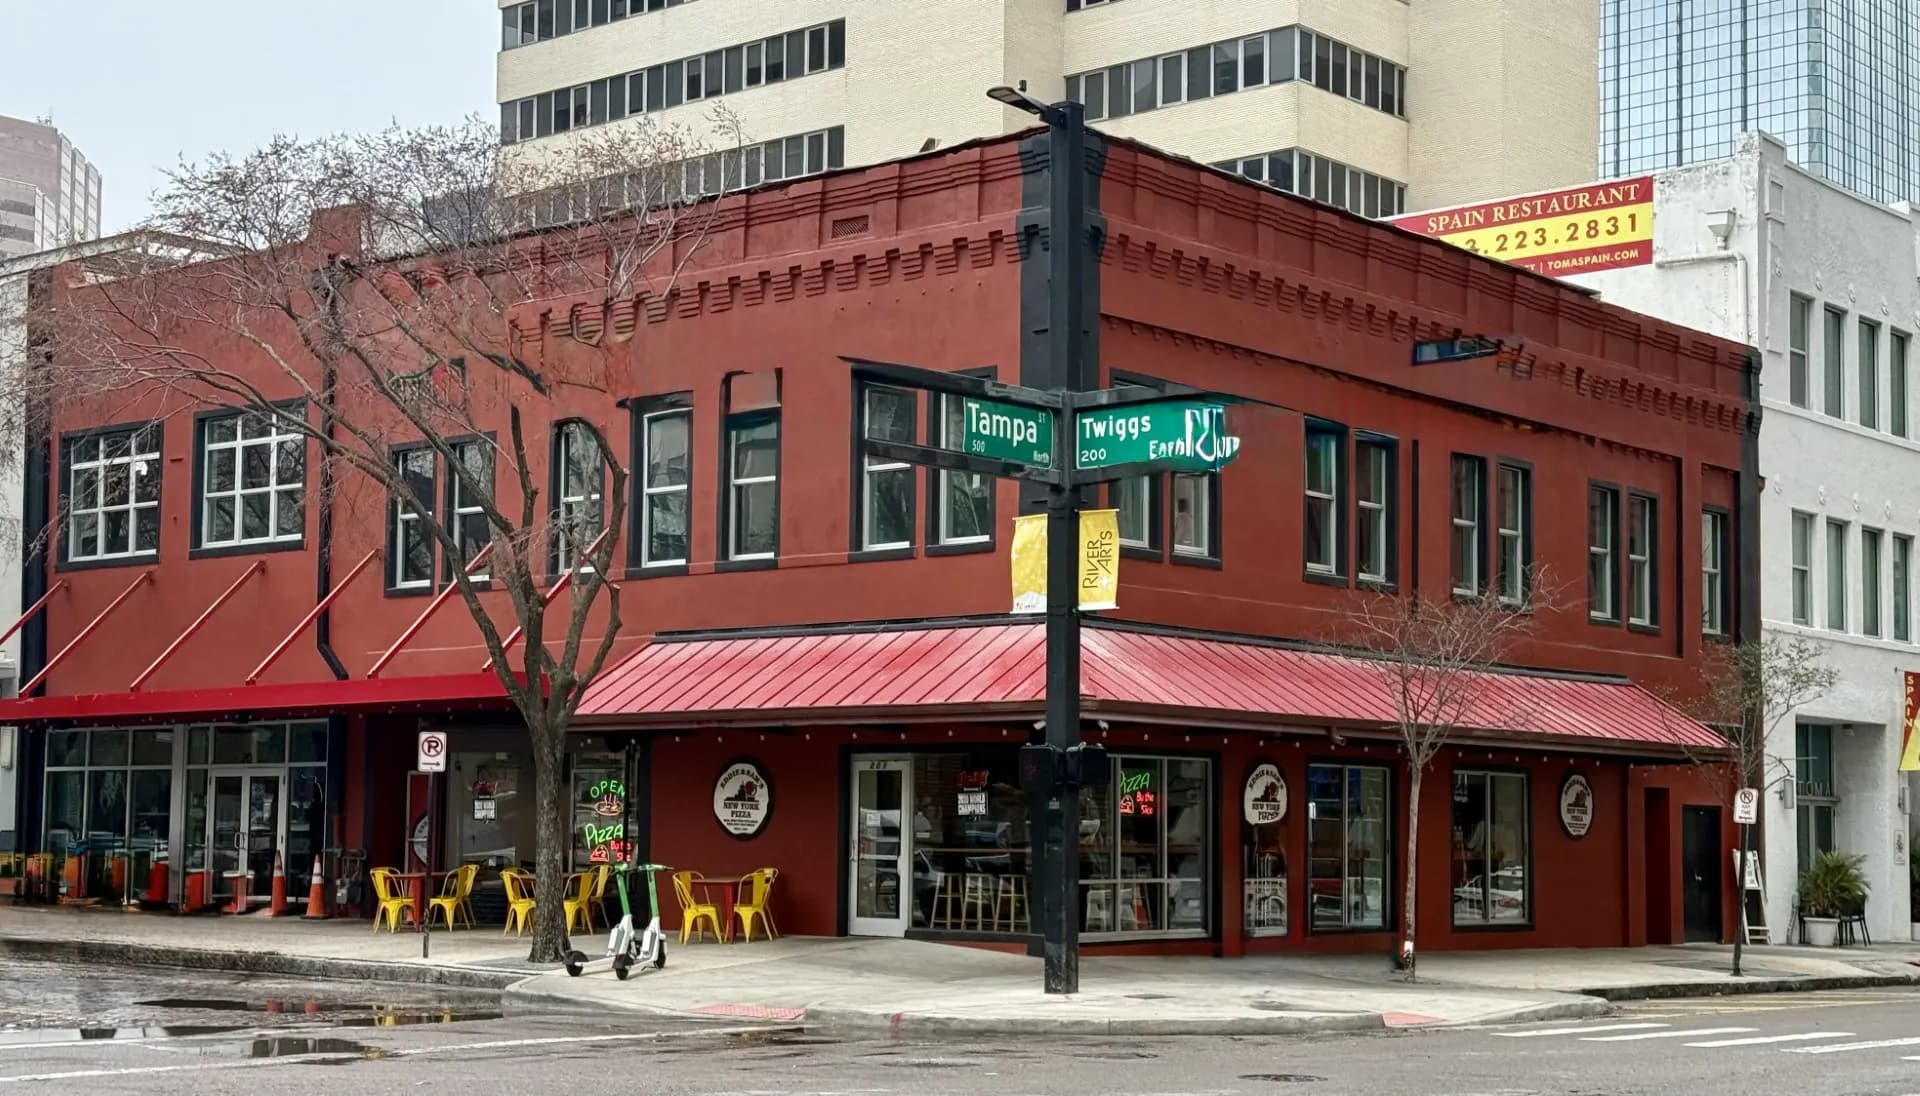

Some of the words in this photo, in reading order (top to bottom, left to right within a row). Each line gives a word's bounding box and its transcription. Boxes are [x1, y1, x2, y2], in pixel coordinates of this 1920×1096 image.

[1427, 208, 1485, 233] SPAIN
[1492, 184, 1640, 223] RESTAURANT
[1547, 249, 1640, 271] TOMASPAIN.COM
[967, 402, 1038, 448] Tampa
[1081, 414, 1152, 442] Twiggs
[972, 439, 986, 453] 500
[1080, 448, 1107, 462] 200
[1081, 539, 1101, 589] RIVER
[1097, 530, 1113, 575] ARTS
[1904, 675, 1916, 728] SPAIN
[590, 779, 626, 799] OPEN
[723, 802, 739, 810] NEW
[740, 802, 760, 811] YORK
[731, 810, 752, 818] PIZZA
[585, 823, 624, 849] PIZZA
